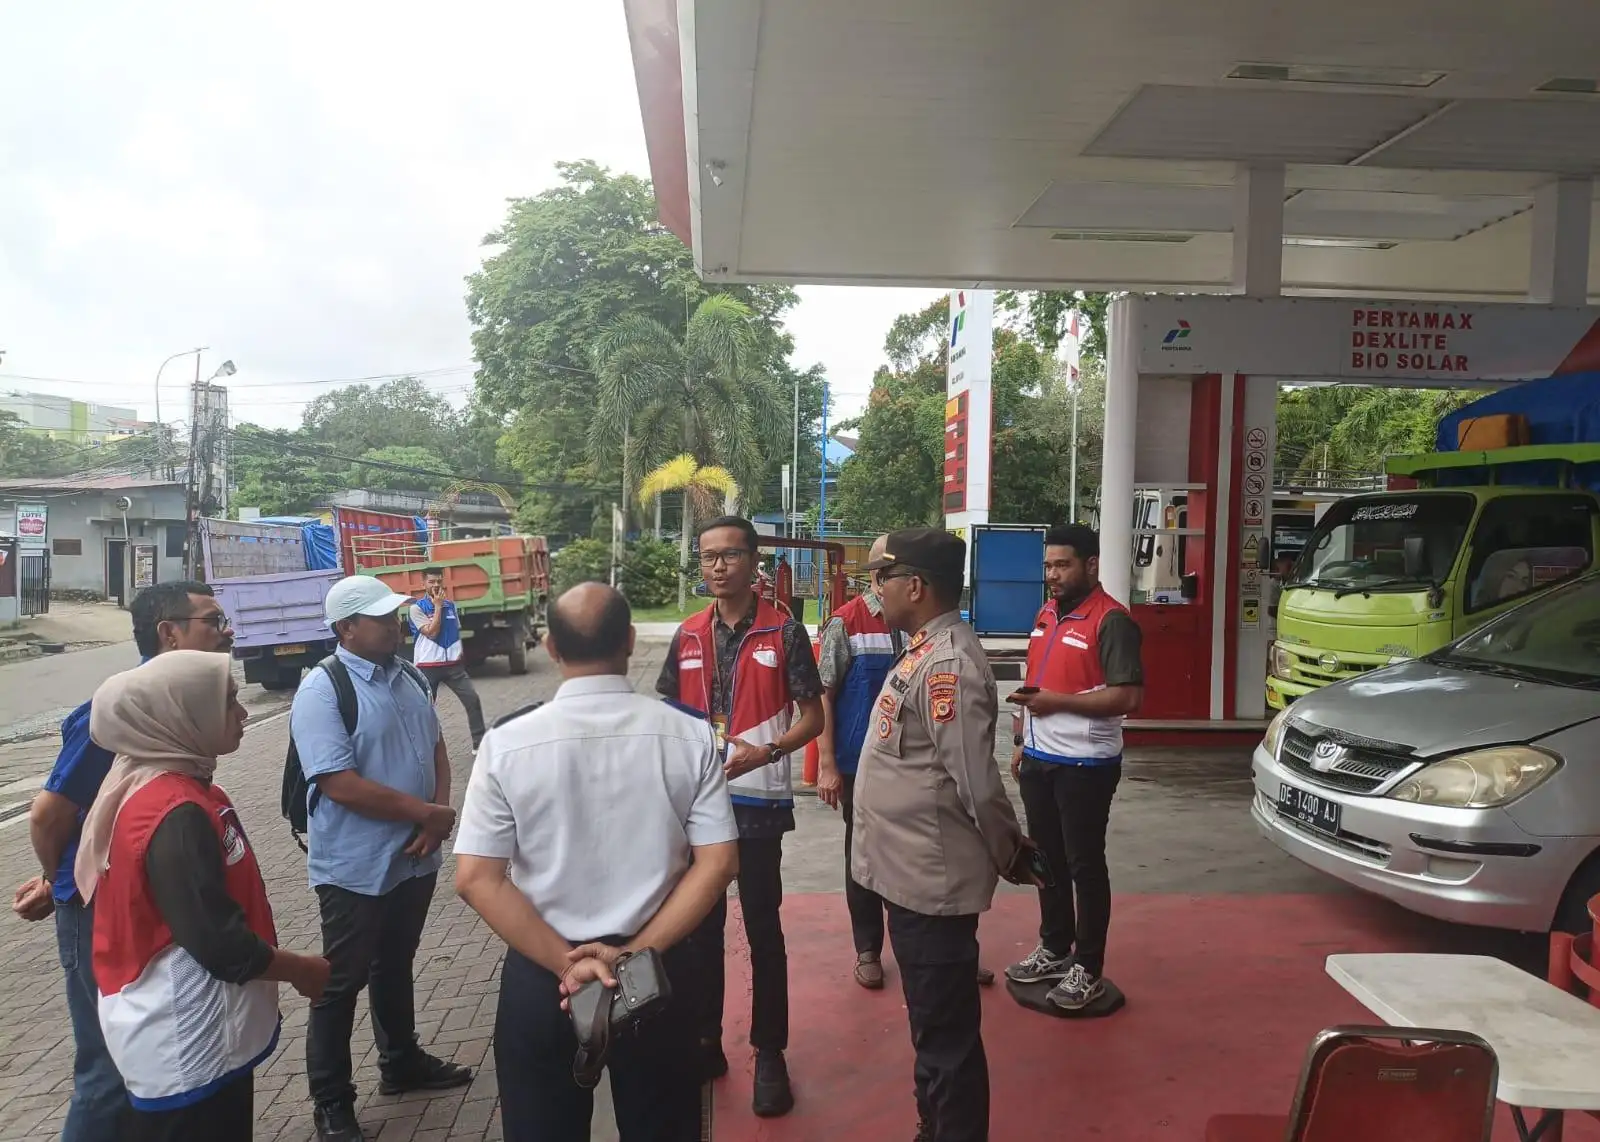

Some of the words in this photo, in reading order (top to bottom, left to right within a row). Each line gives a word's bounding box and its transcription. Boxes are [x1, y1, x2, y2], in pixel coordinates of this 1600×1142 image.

[1353, 310, 1473, 330] PERTAMAX
[1352, 331, 1447, 350] DEXLITE
[1352, 352, 1389, 370] BIO
[1396, 353, 1468, 371] SOLAR
[1280, 784, 1292, 805] DE
[1298, 791, 1319, 816] 1400
[1323, 801, 1337, 823] AJ
